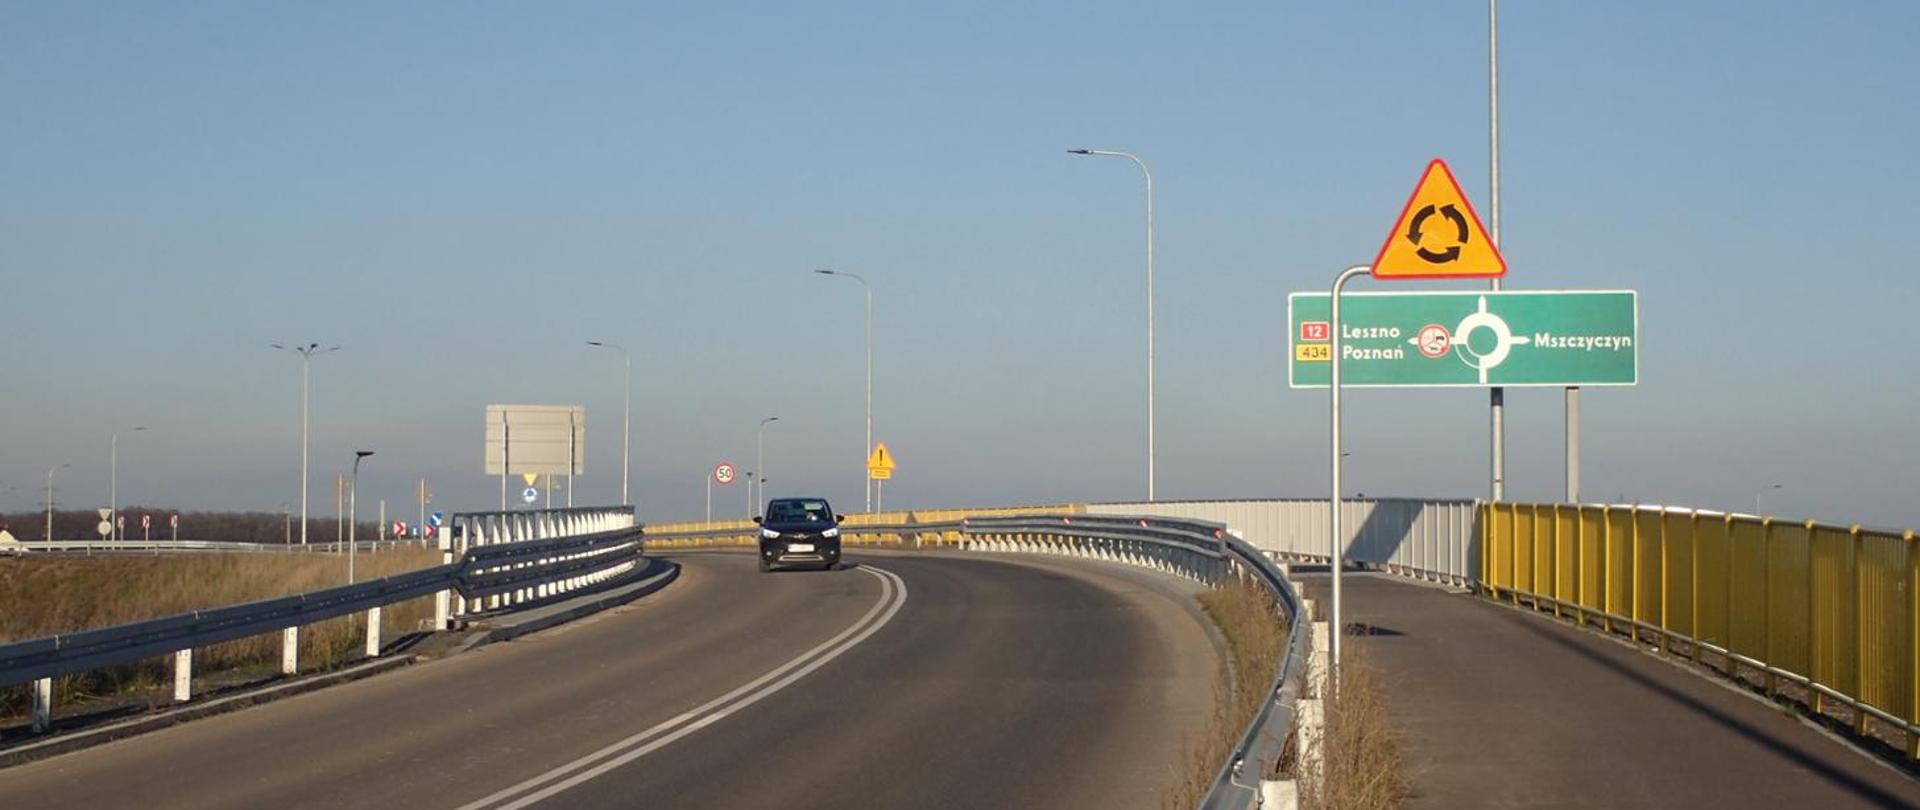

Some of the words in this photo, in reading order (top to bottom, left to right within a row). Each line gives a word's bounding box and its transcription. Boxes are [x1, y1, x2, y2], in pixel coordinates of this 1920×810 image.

[1308, 325, 1322, 338] 12
[1343, 324, 1400, 339] Leszno
[1534, 332, 1632, 352] Mszczyczyn
[1303, 347, 1327, 359] 434
[1343, 344, 1404, 360] Poznań
[719, 468, 731, 479] 50
